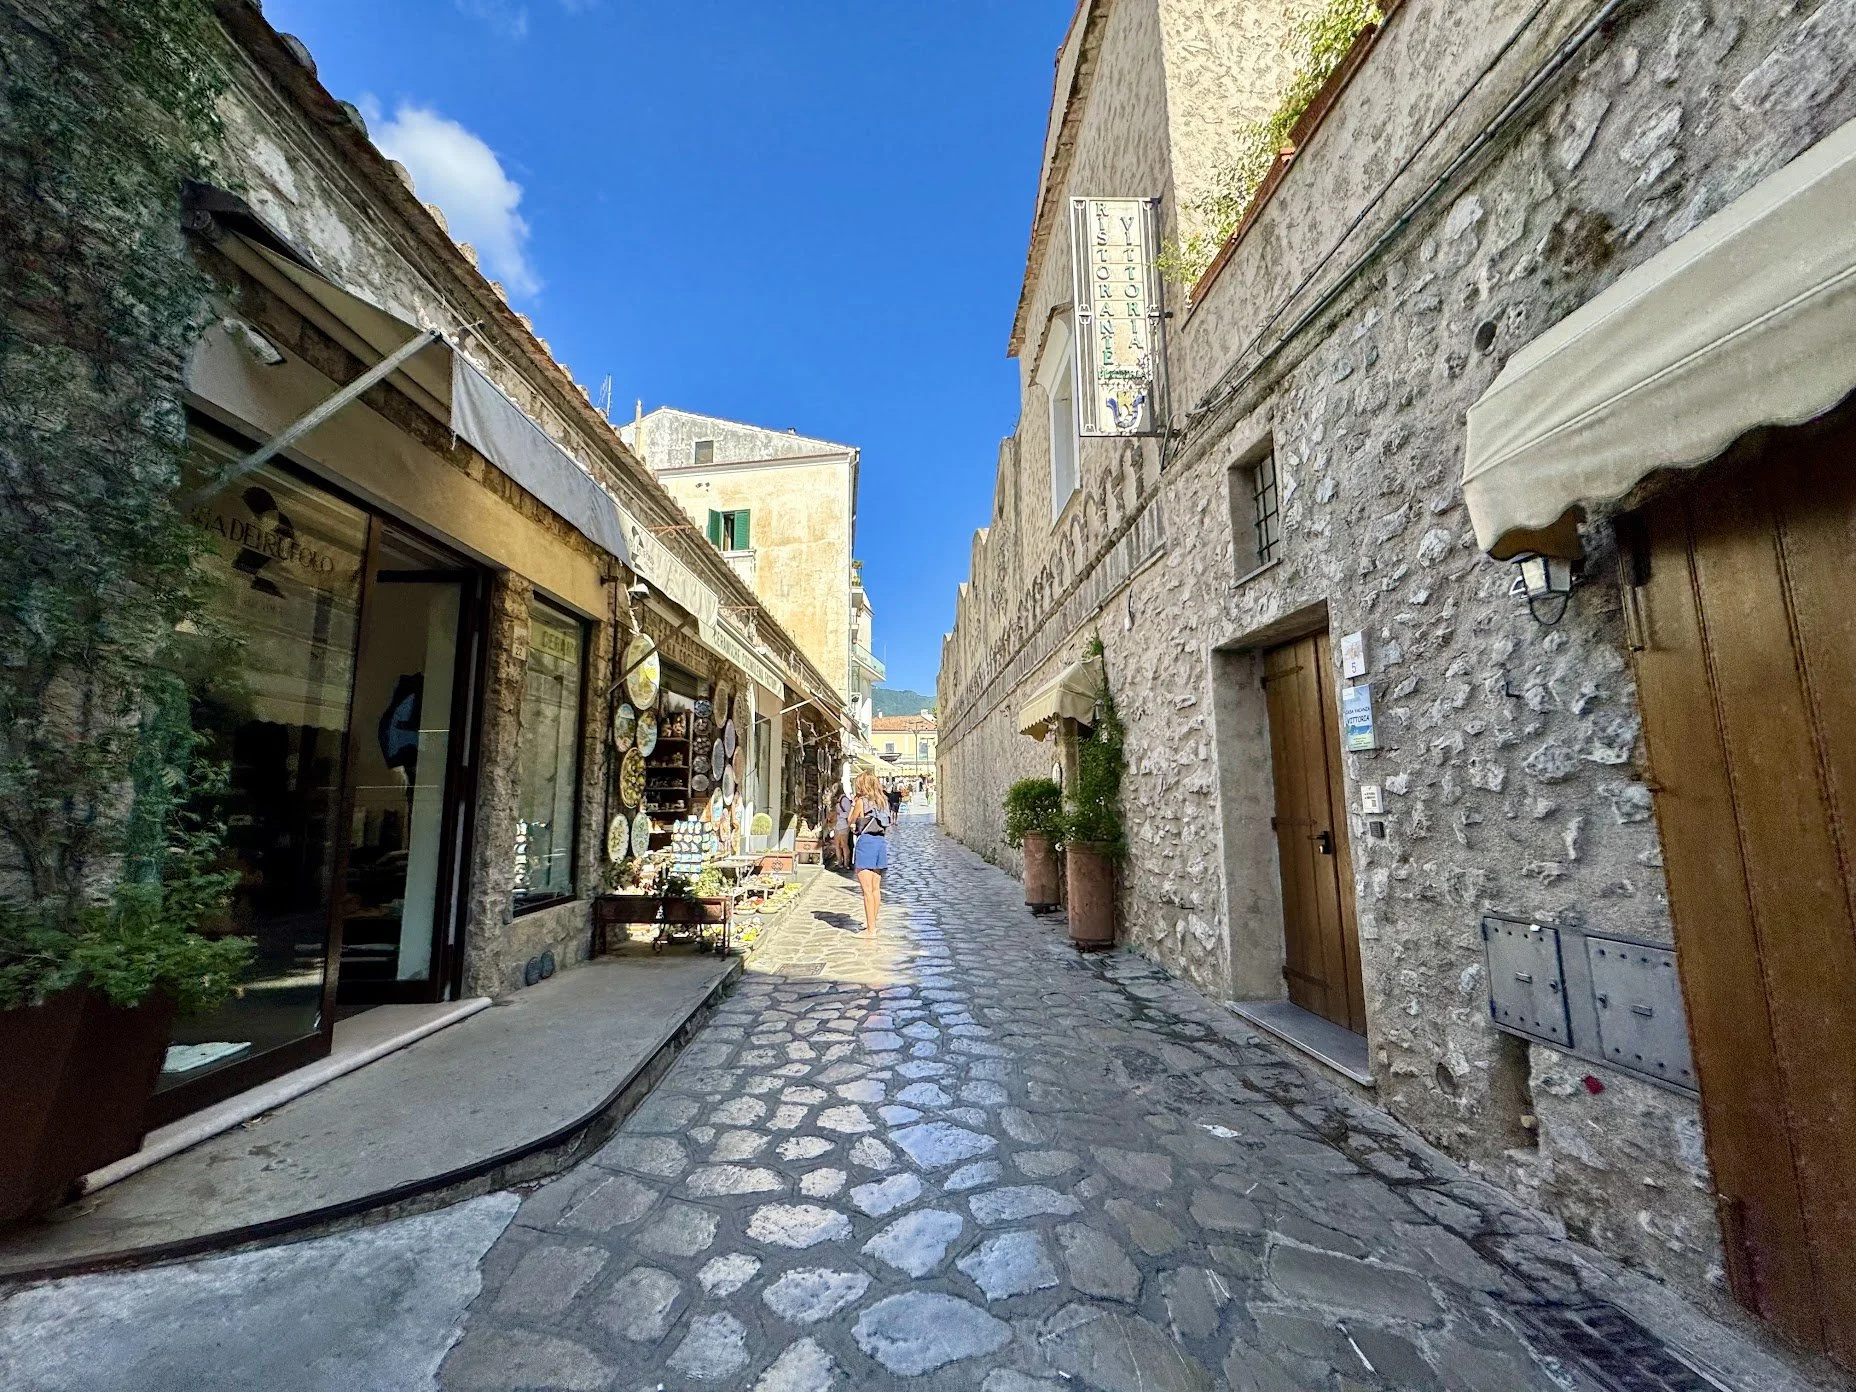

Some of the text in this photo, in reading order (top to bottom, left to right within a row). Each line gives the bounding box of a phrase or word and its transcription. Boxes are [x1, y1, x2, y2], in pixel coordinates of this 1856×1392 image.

[1095, 202, 1115, 366] RISTORANTE
[1119, 216, 1144, 350] VITTORIA
[1351, 661, 1357, 674] 5
[1347, 715, 1370, 724] VITTORIA
